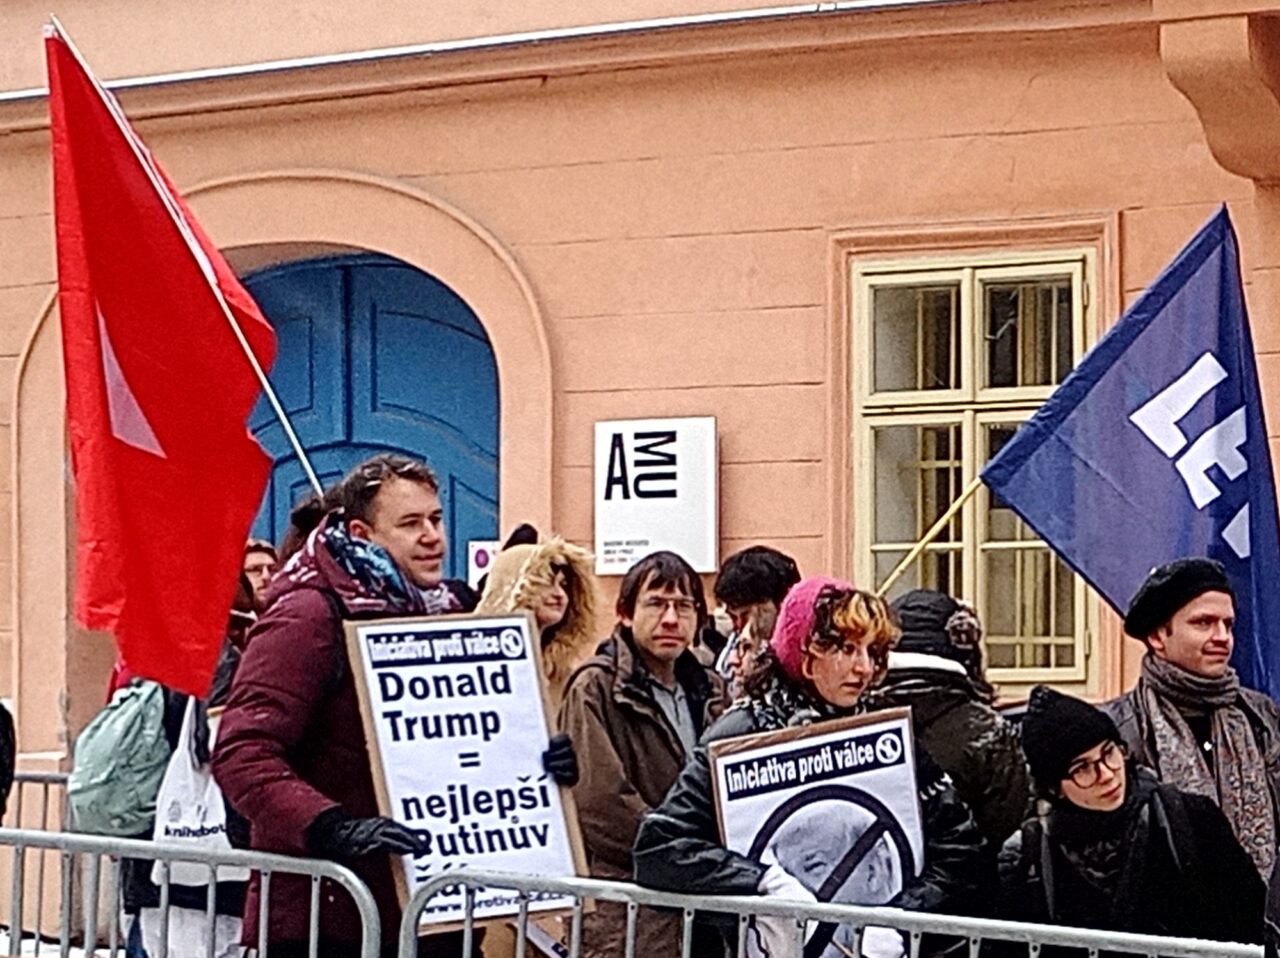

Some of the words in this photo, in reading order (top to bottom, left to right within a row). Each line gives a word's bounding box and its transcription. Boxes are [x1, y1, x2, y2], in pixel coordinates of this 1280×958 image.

[377, 664, 512, 702] Donald
[382, 710, 501, 742] Trump
[727, 757, 796, 793] Iniciativa
[800, 746, 834, 783] proti
[834, 742, 875, 771] válce
[401, 775, 551, 824] nejlepší
